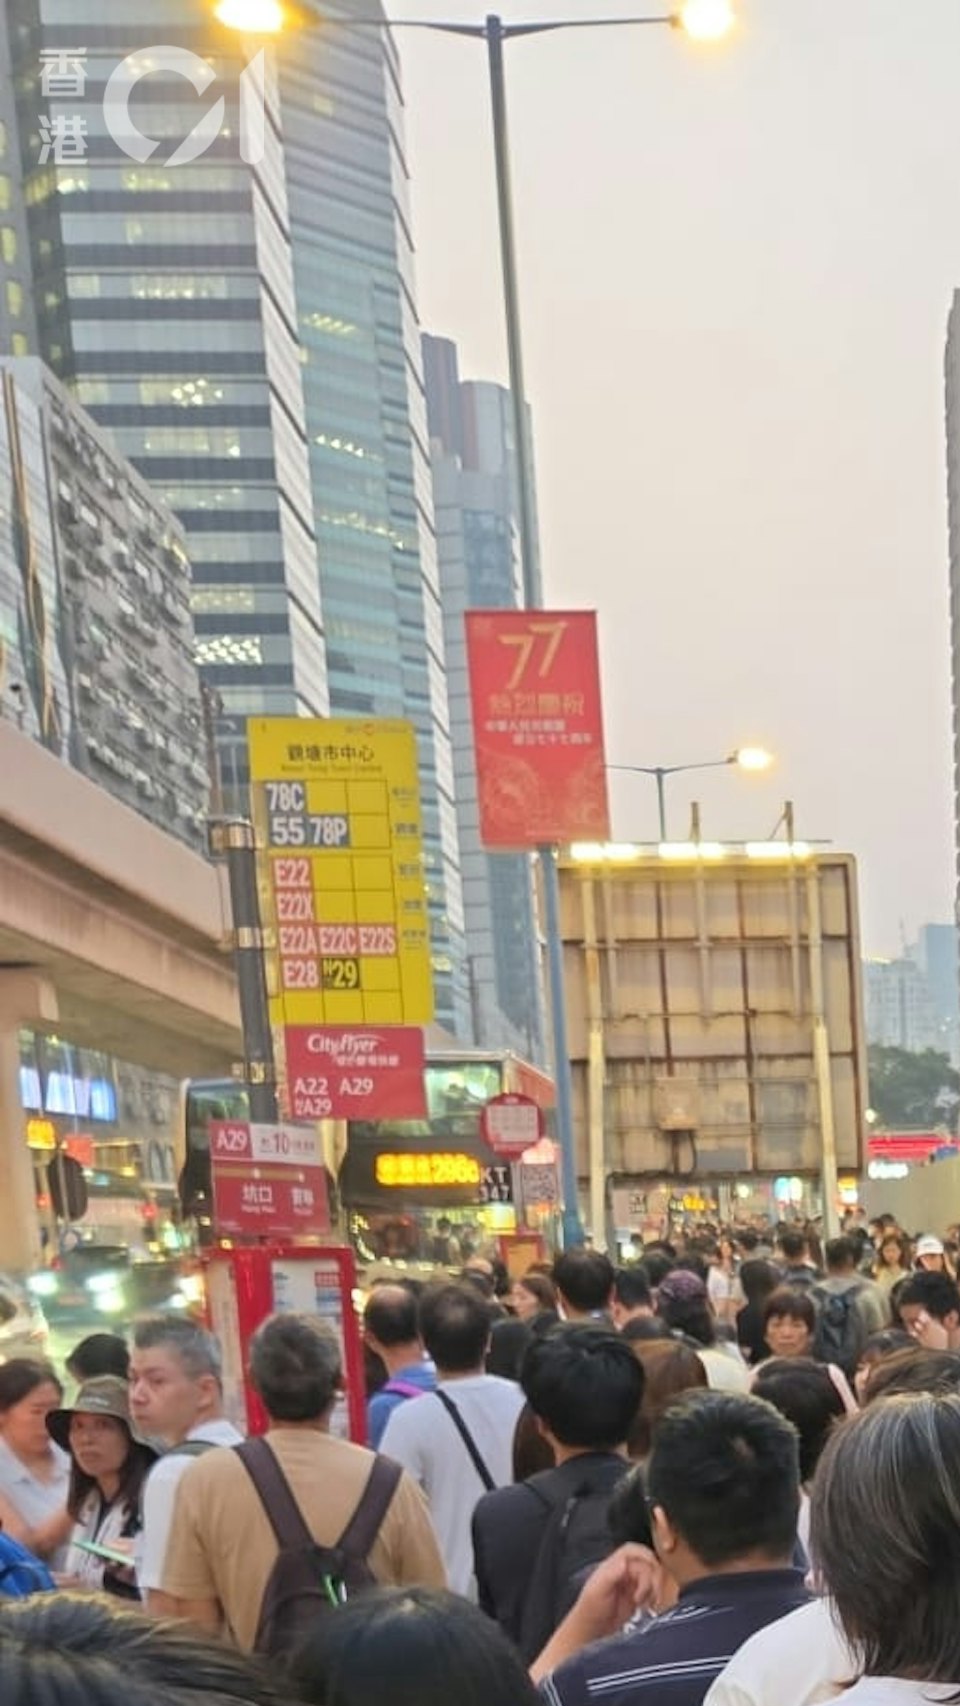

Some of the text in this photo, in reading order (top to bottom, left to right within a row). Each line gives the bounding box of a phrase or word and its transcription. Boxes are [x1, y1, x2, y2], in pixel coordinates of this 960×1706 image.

[498, 620, 567, 690] 77
[287, 744, 375, 762] 觀塘市中心
[266, 783, 305, 811] 78C
[272, 816, 348, 845] 55 78P
[275, 858, 310, 888] E22
[277, 891, 315, 921] E22X
[279, 926, 318, 955] E22A
[319, 926, 357, 955] E22C
[359, 926, 397, 954] E22S
[283, 959, 319, 988] E28
[307, 1033, 385, 1057] Cityflyer
[294, 1077, 374, 1095] A22 A29
[216, 1129, 248, 1150] A29
[242, 1184, 273, 1203] 坑口
